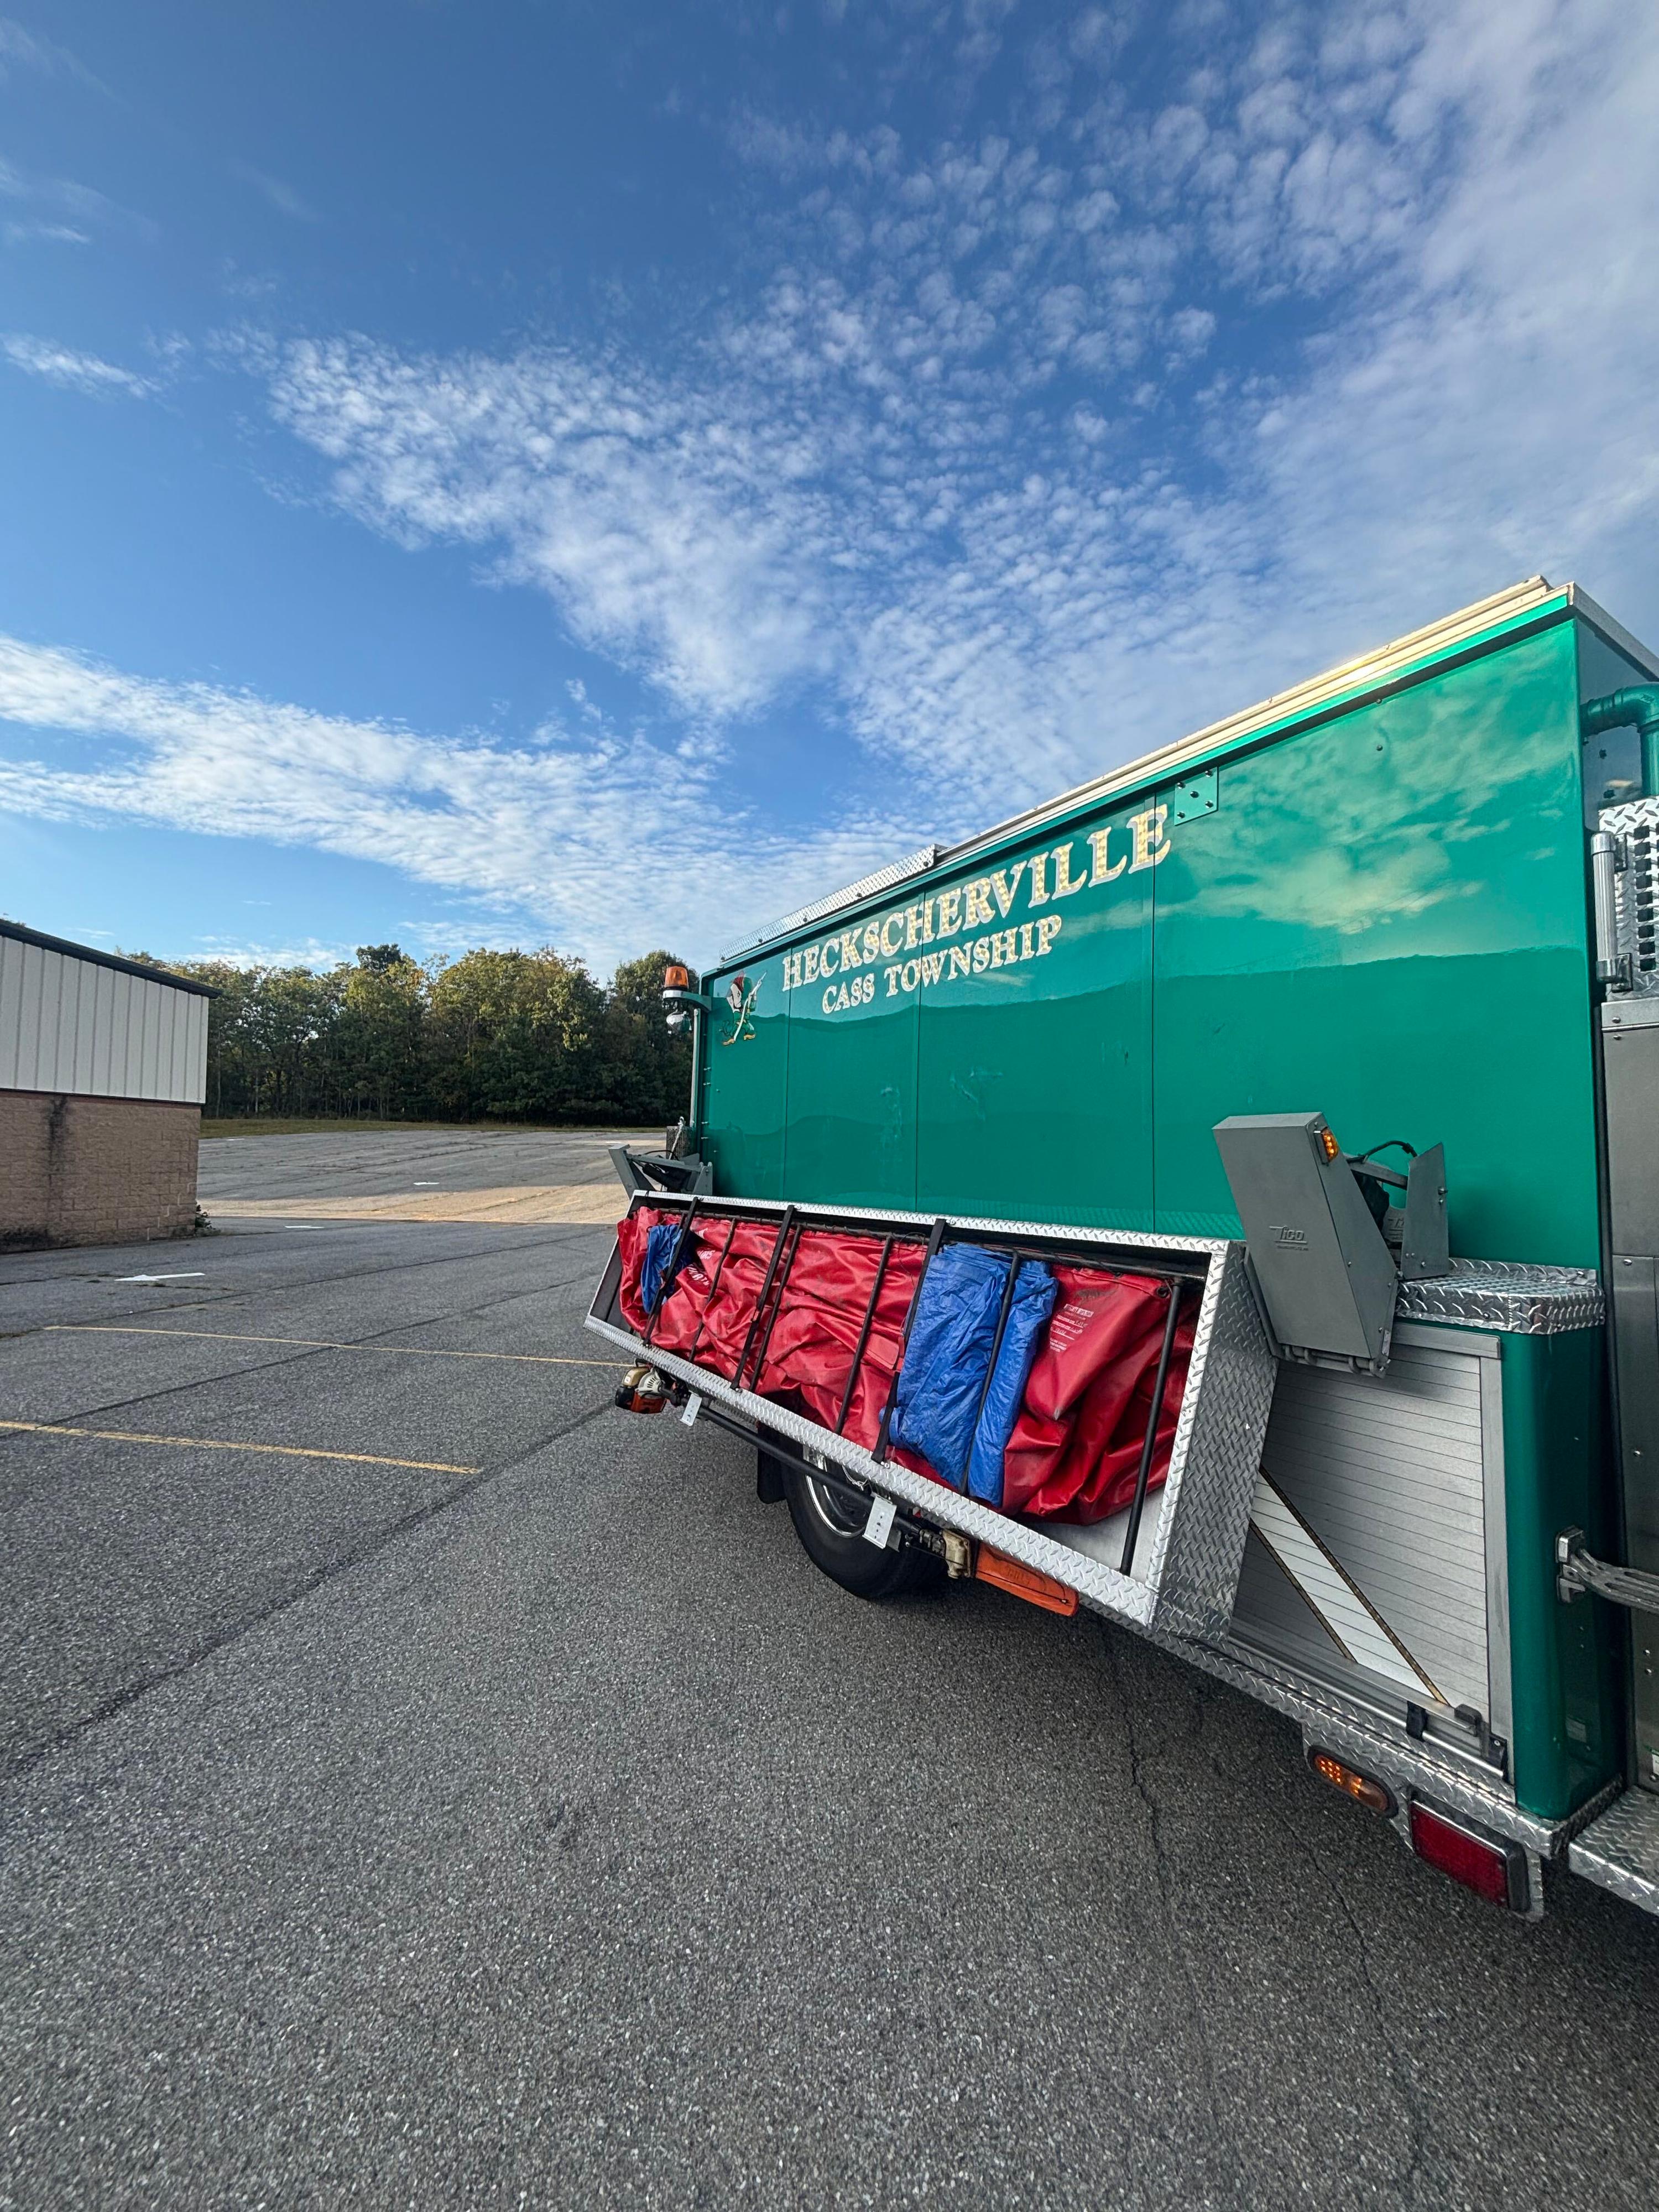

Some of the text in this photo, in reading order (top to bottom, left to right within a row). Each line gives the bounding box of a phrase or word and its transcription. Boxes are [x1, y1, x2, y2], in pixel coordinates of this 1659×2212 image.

[782, 804, 1171, 992] HECKSCHERVILLE
[822, 915, 1062, 1014] CASS TOWNSHIP
